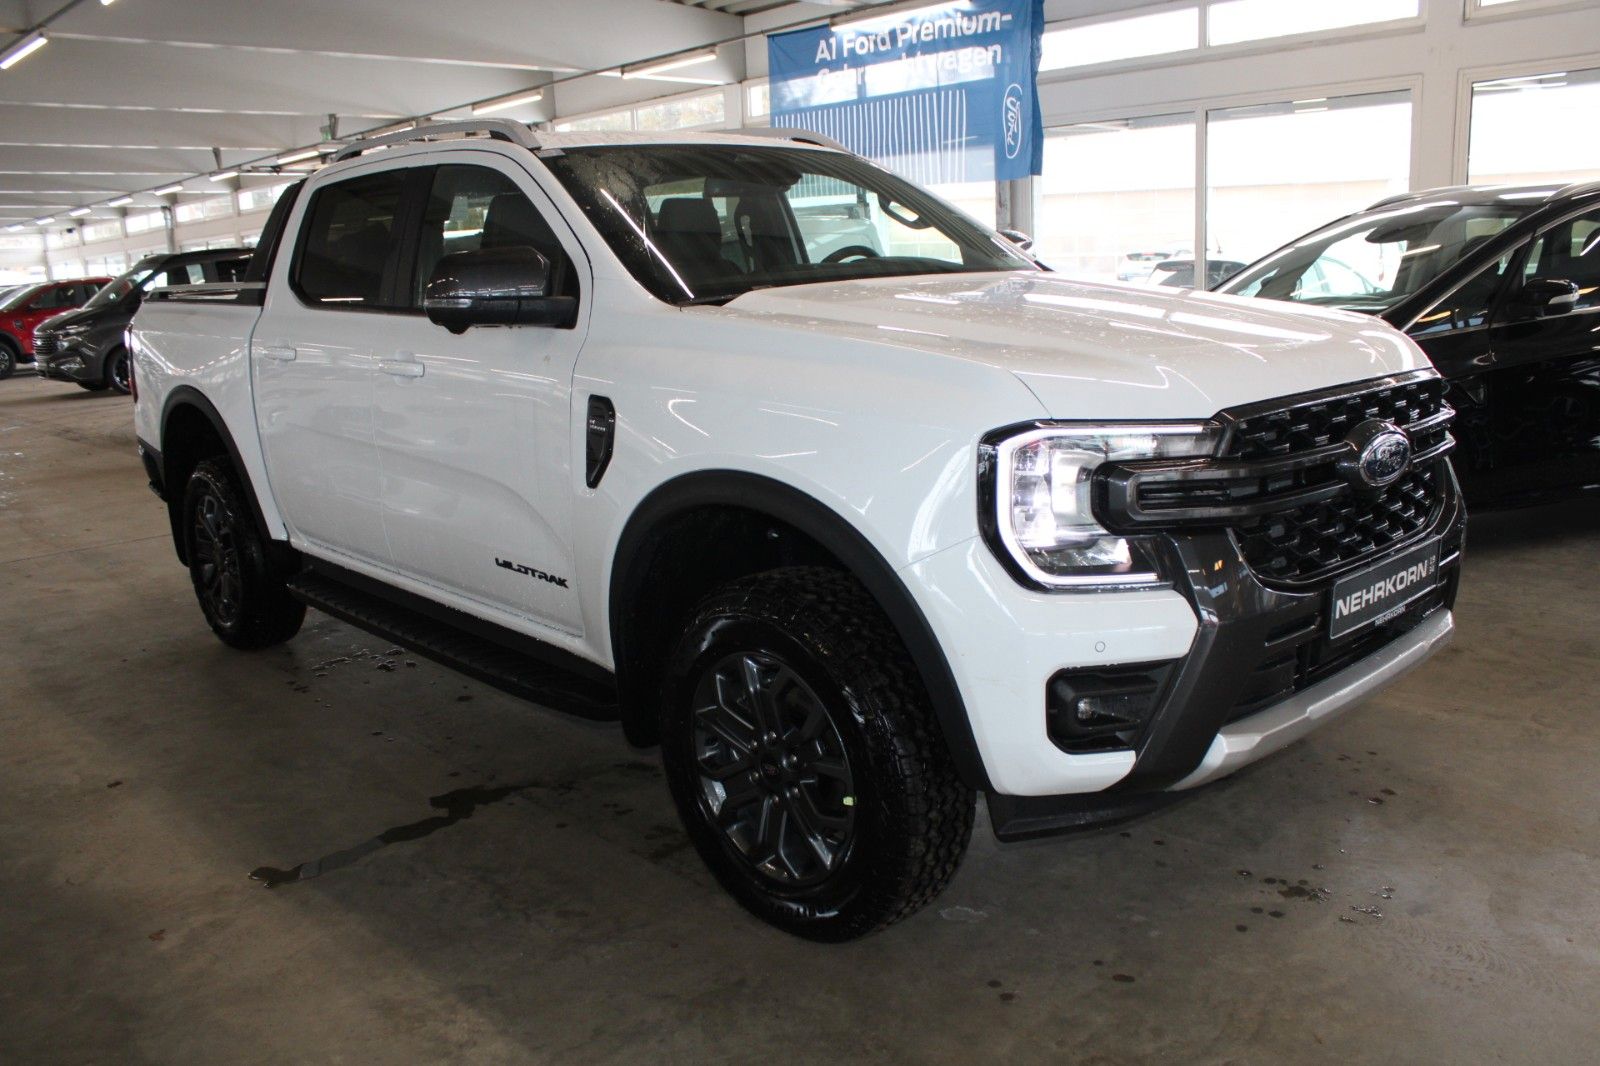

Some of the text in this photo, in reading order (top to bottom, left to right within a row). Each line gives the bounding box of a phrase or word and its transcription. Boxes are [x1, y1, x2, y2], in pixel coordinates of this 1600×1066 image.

[815, 11, 1012, 63] A1 Ford Premium-
[1006, 97, 1020, 146] Ford
[495, 557, 569, 589] WILDTRAK
[1335, 560, 1428, 619] NEHRKORN
